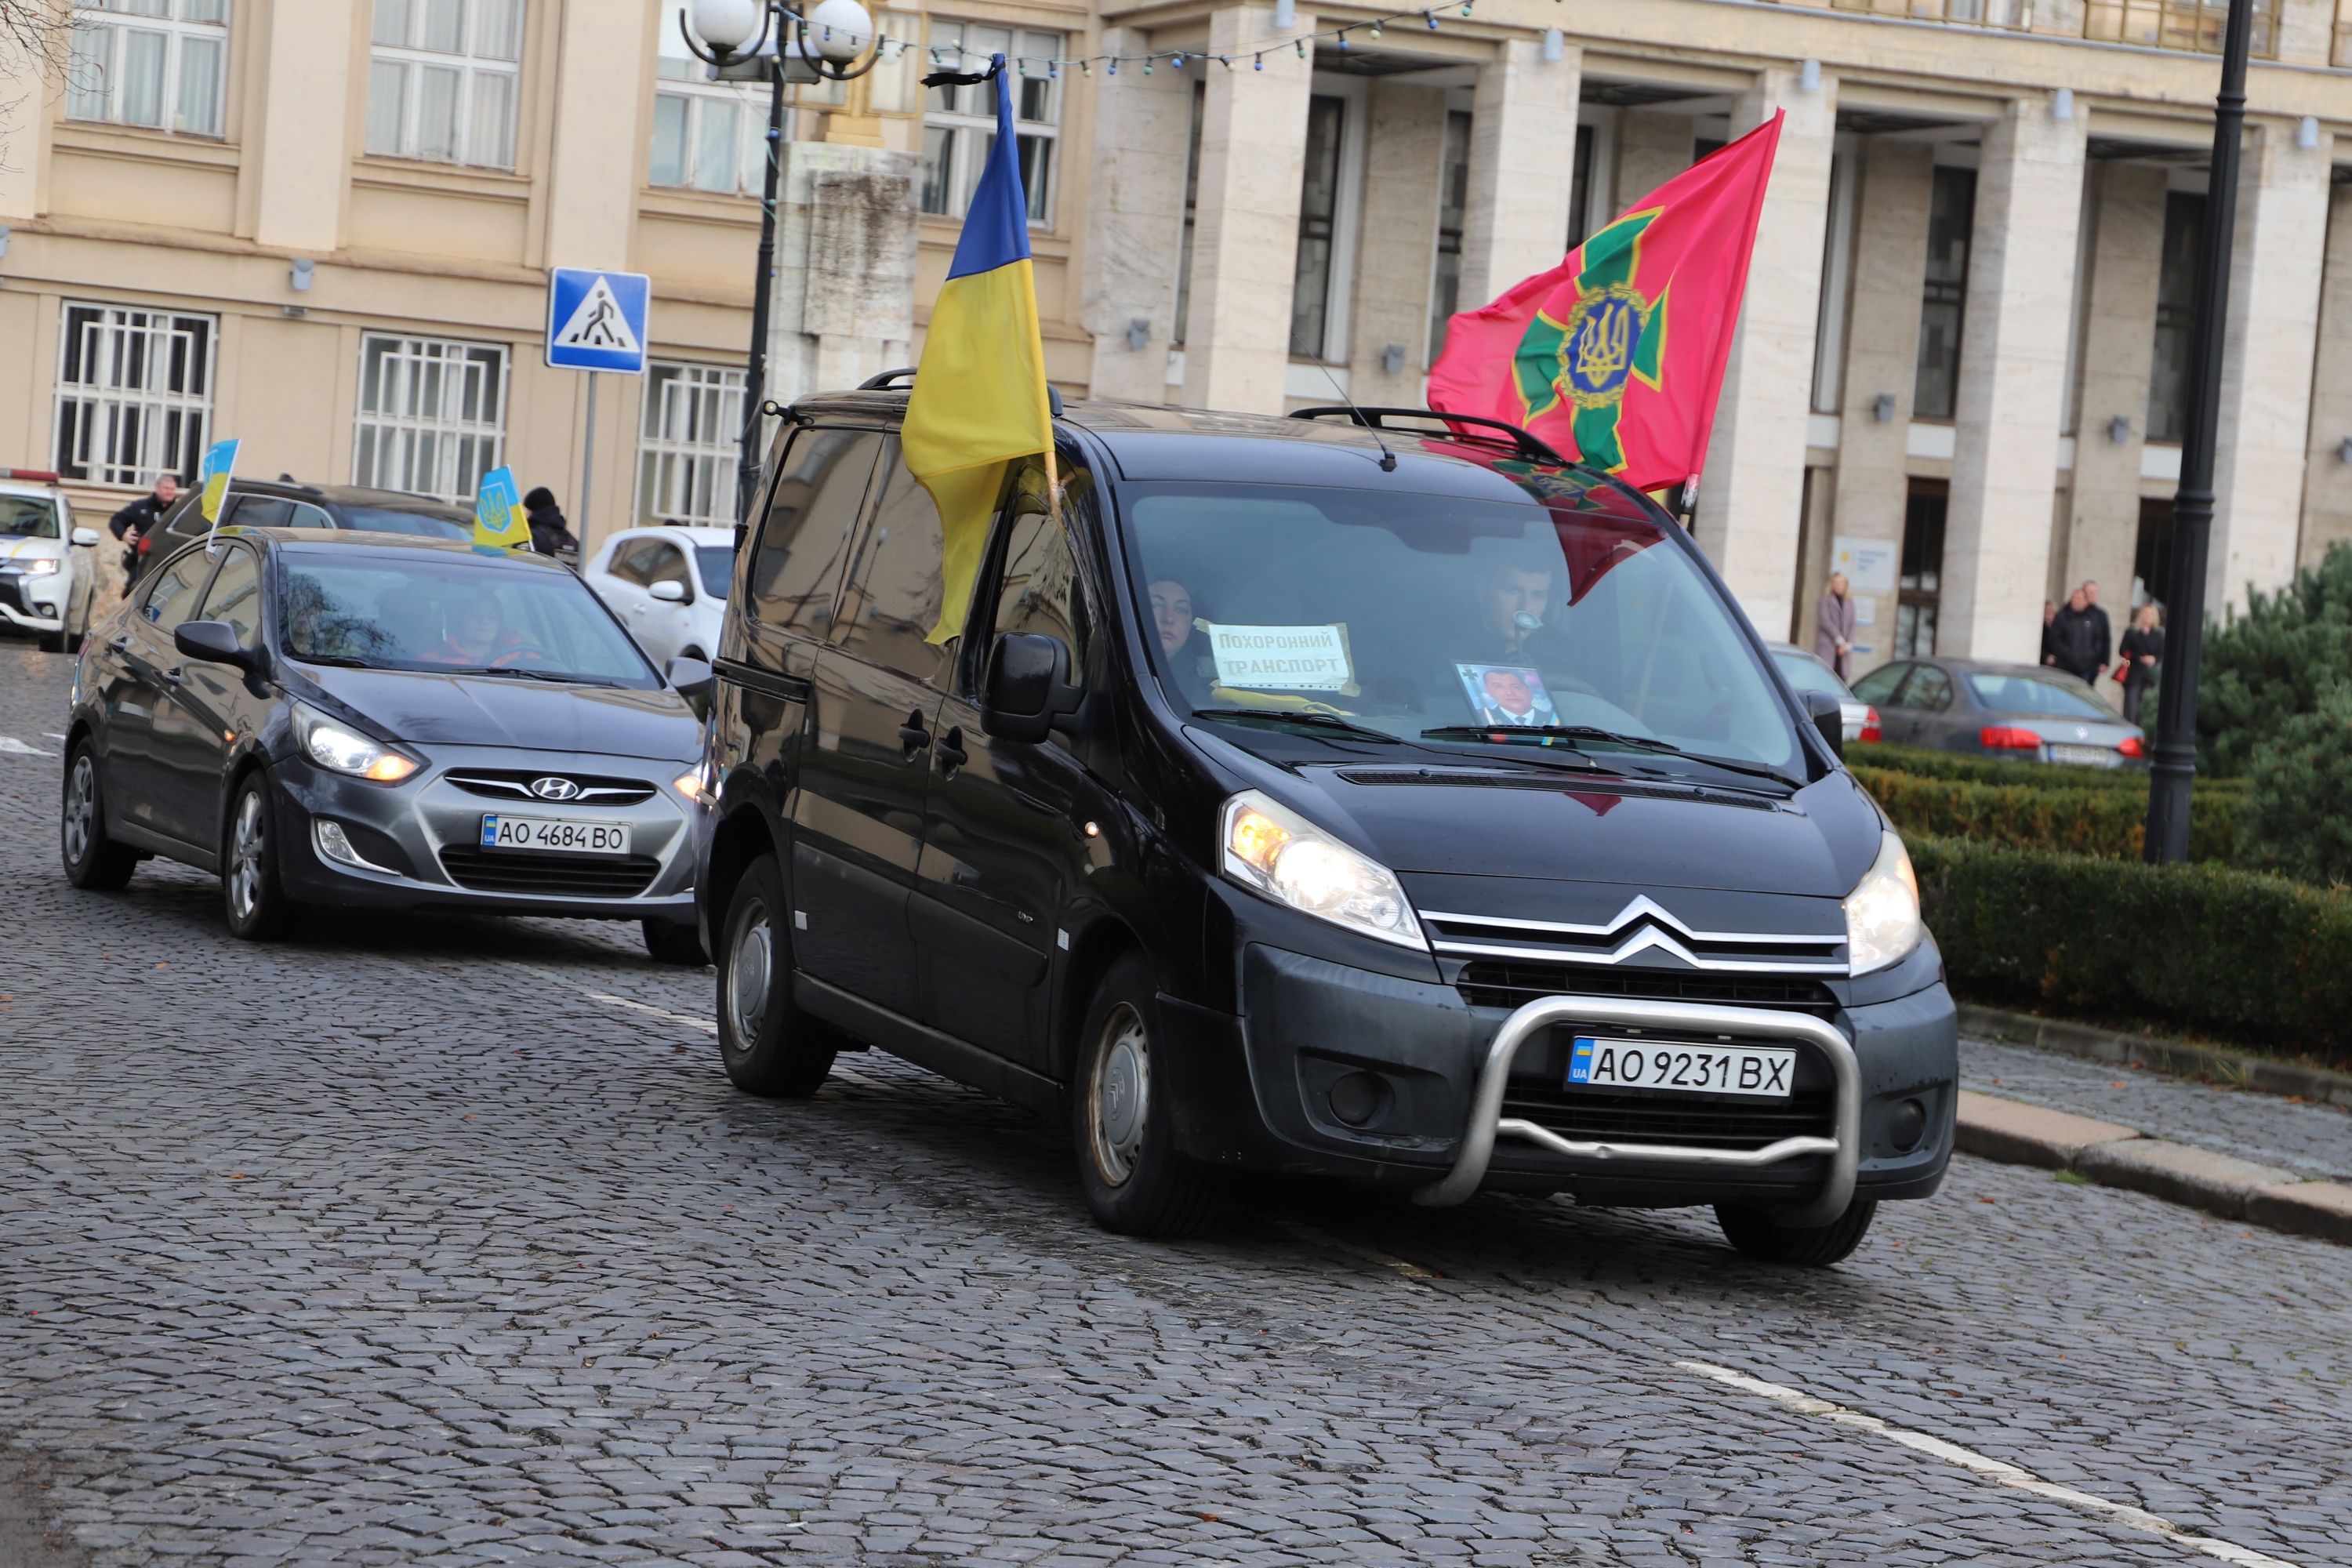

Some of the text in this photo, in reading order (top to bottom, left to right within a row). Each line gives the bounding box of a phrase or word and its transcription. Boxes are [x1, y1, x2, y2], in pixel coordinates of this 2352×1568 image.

[1218, 631, 1333, 649] ПОХОРОННИЙ
[1223, 659, 1338, 674] ТРАНСПОРТ
[498, 822, 622, 849] AO 4684 BO
[1572, 1068, 1588, 1080] UA
[1593, 1047, 1790, 1091] AO 9231 BX
